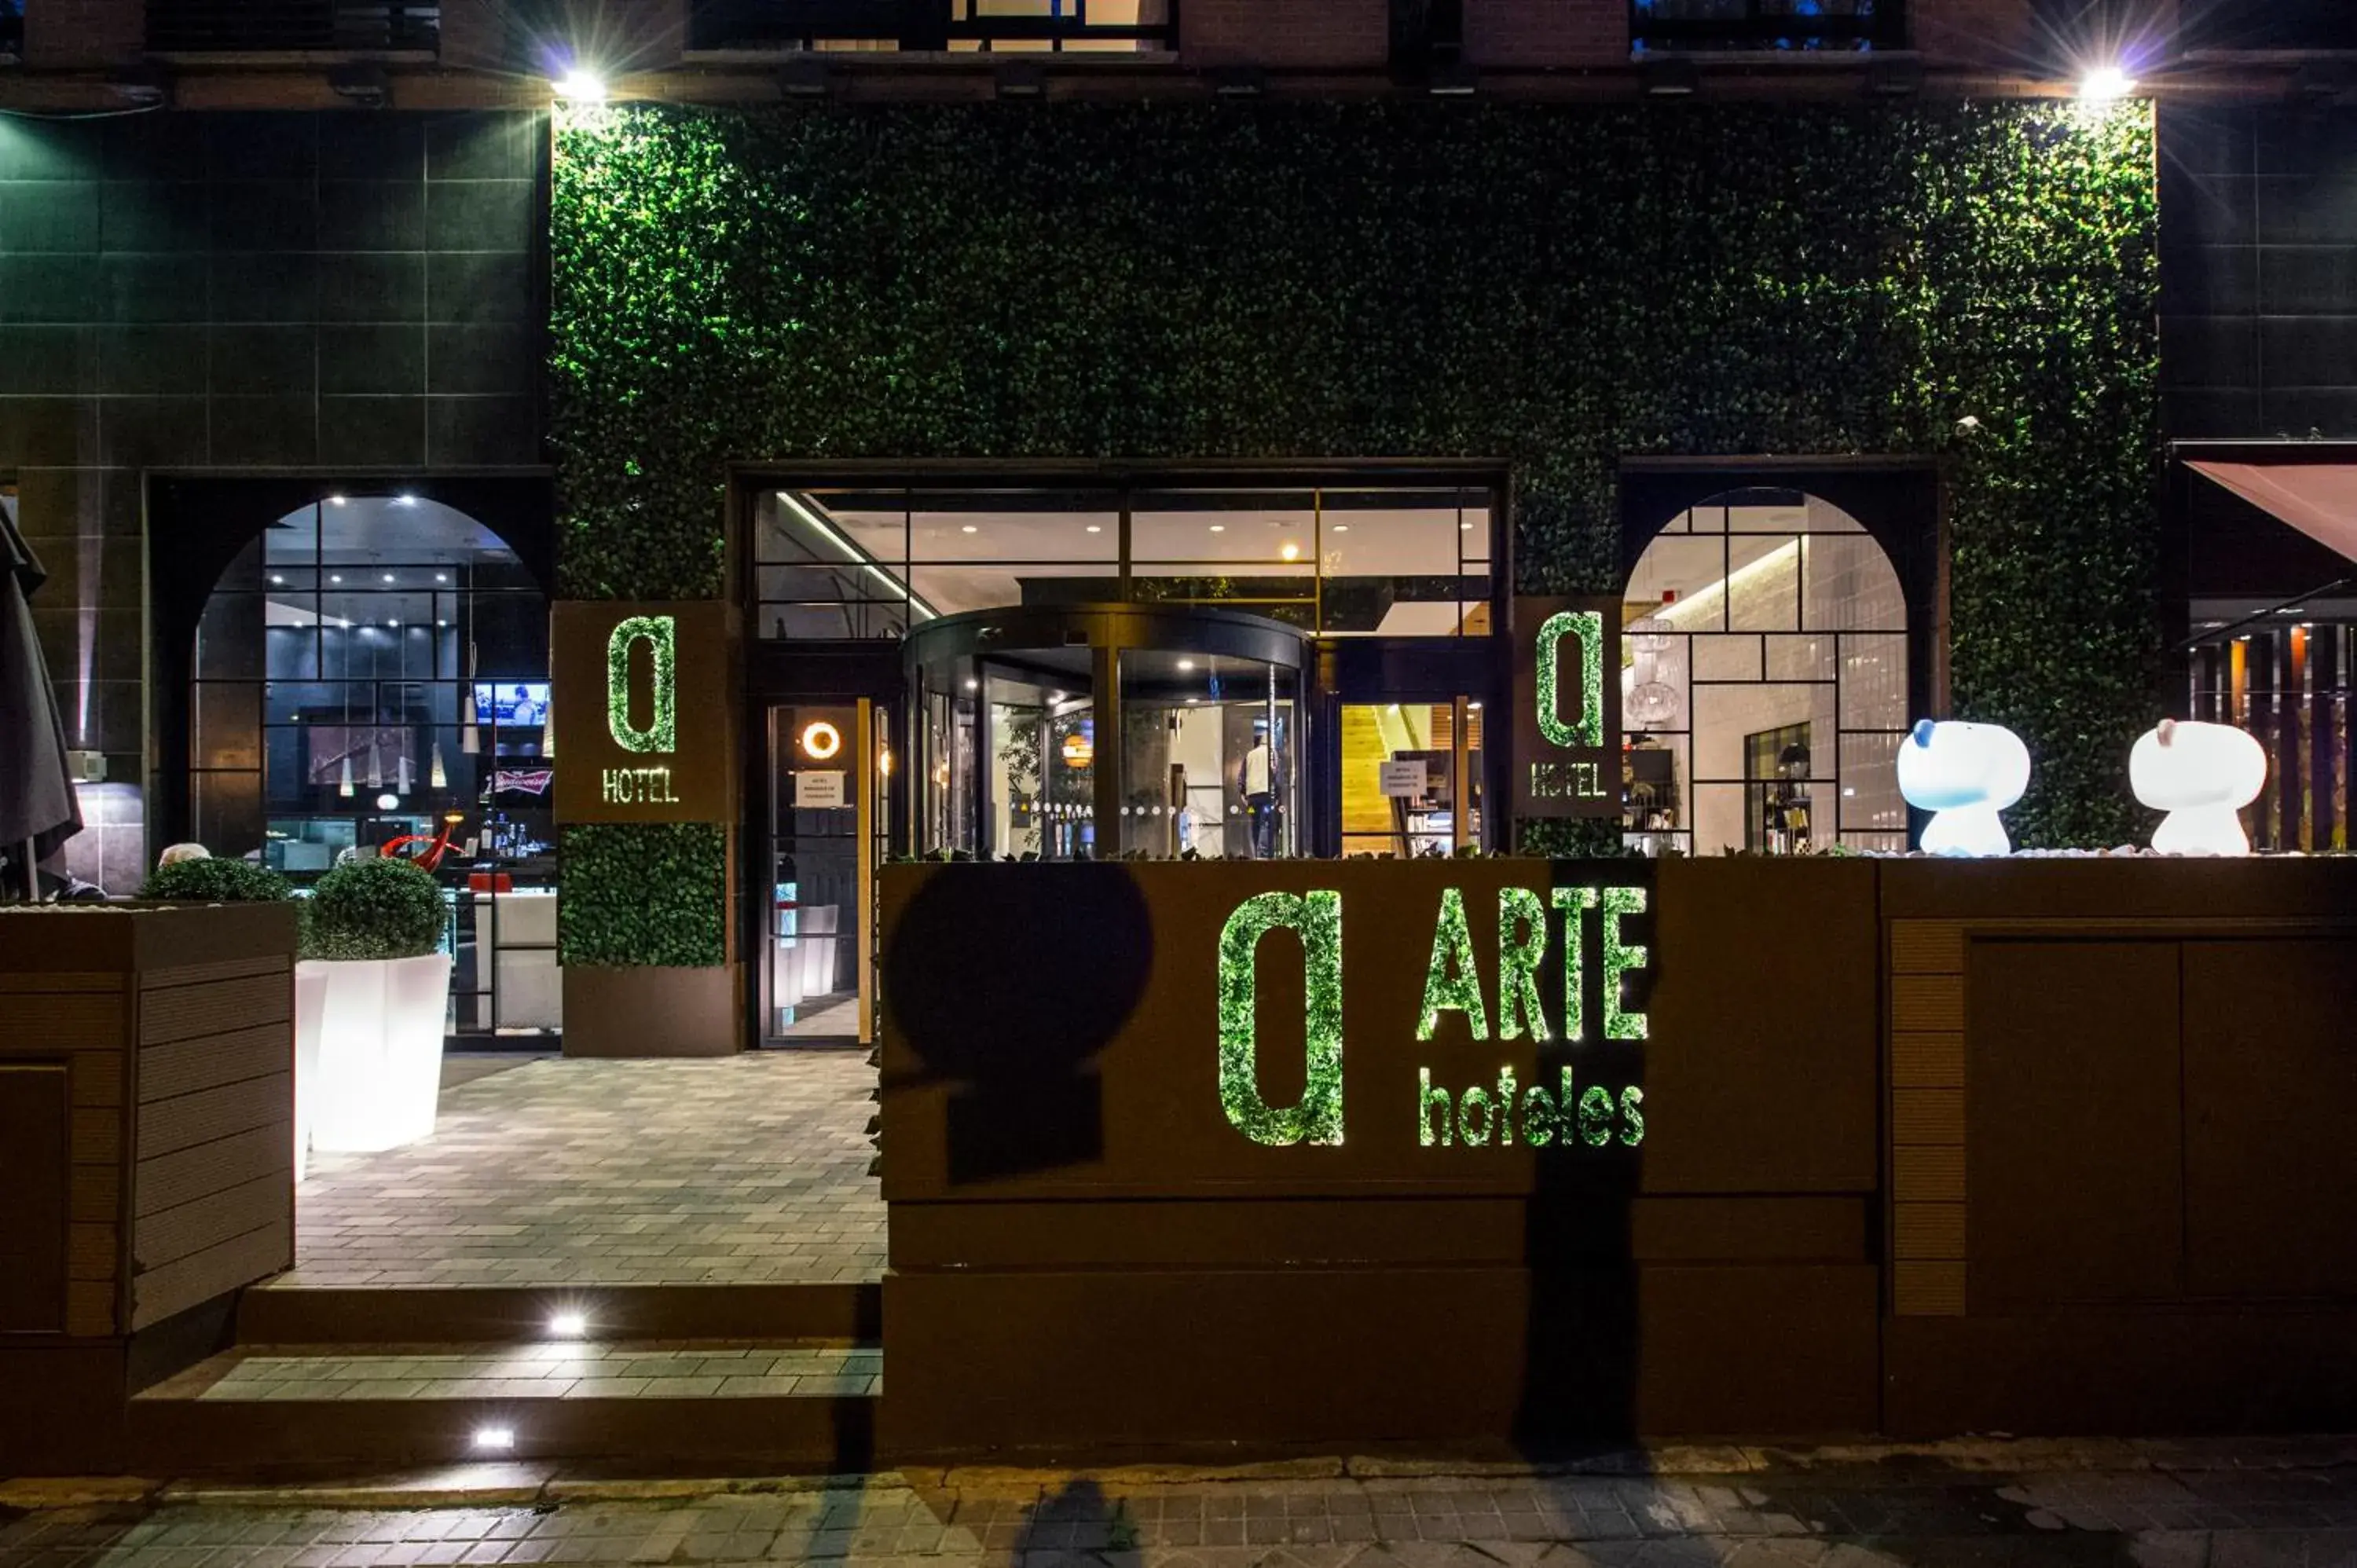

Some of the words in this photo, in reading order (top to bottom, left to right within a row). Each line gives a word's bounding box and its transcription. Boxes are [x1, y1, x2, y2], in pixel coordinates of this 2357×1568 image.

[603, 765, 680, 804] HOTEL
[1416, 887, 1650, 1043] ARTE
[1419, 1064, 1644, 1147] hoteles
